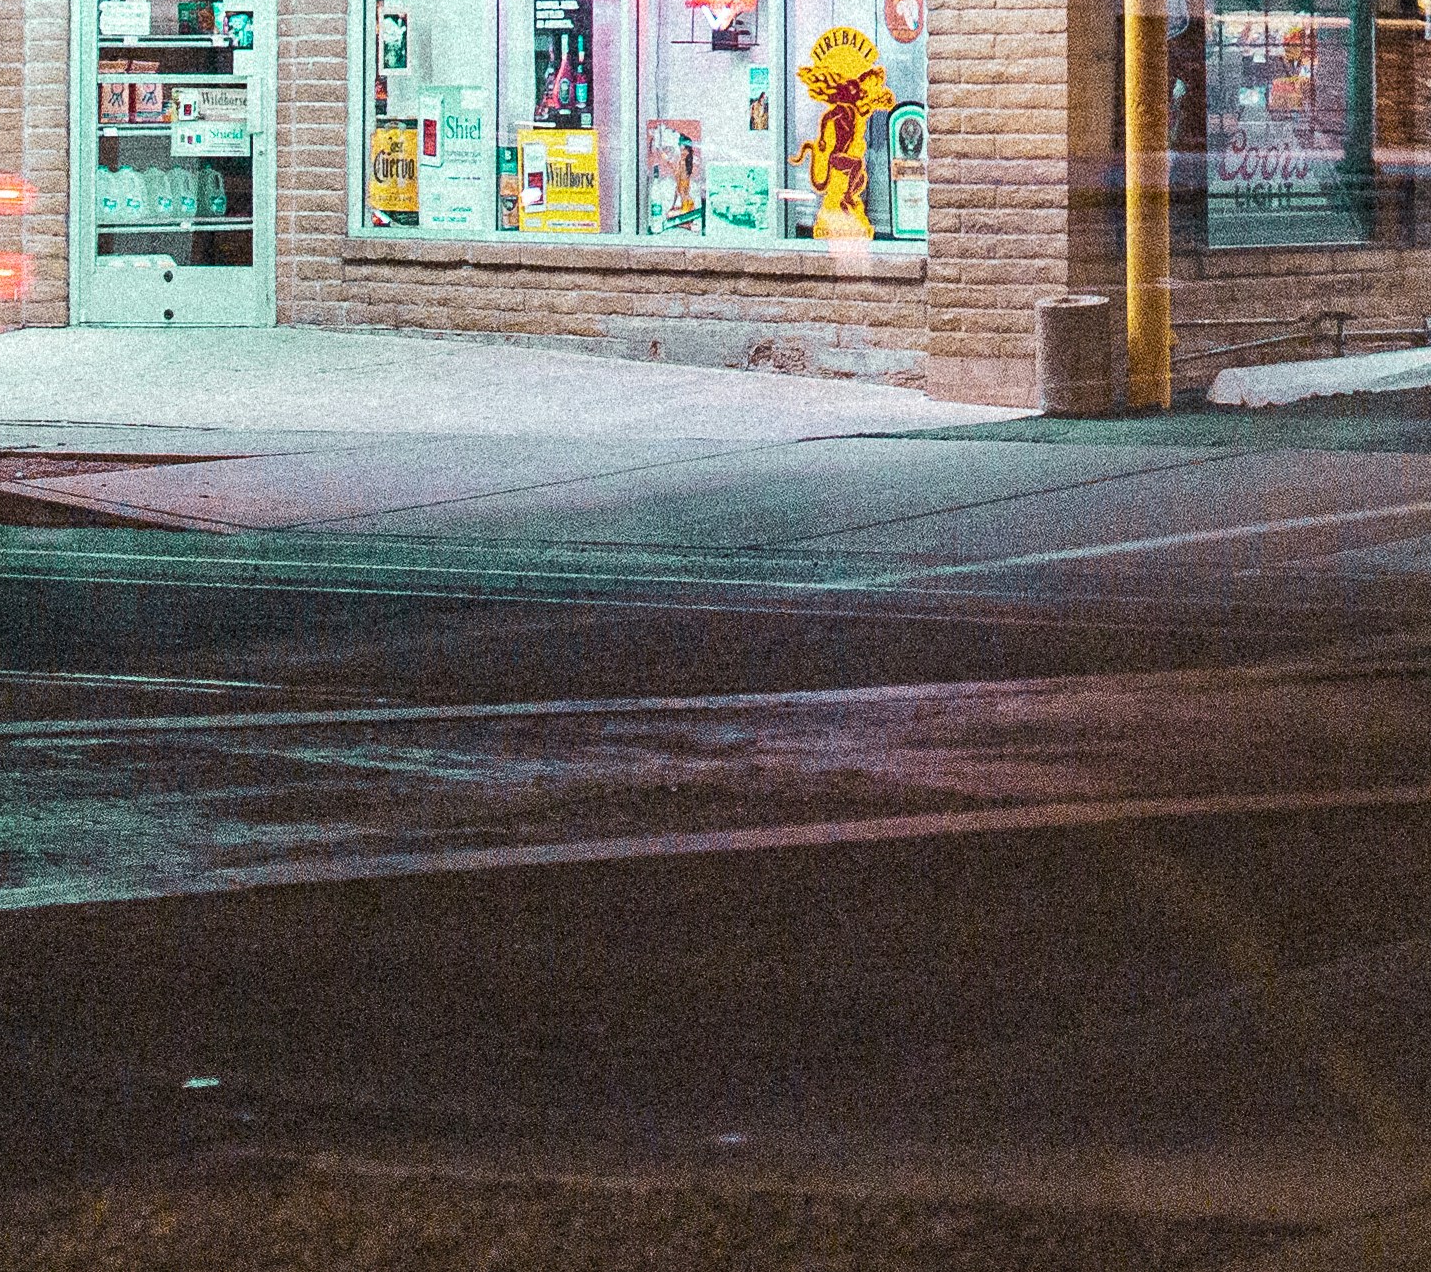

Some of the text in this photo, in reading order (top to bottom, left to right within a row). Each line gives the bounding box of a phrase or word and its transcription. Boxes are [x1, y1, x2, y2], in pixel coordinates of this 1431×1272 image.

[812, 29, 873, 63] FIREBALL
[373, 150, 415, 184] Cuervo
[1218, 128, 1309, 181] Coors
